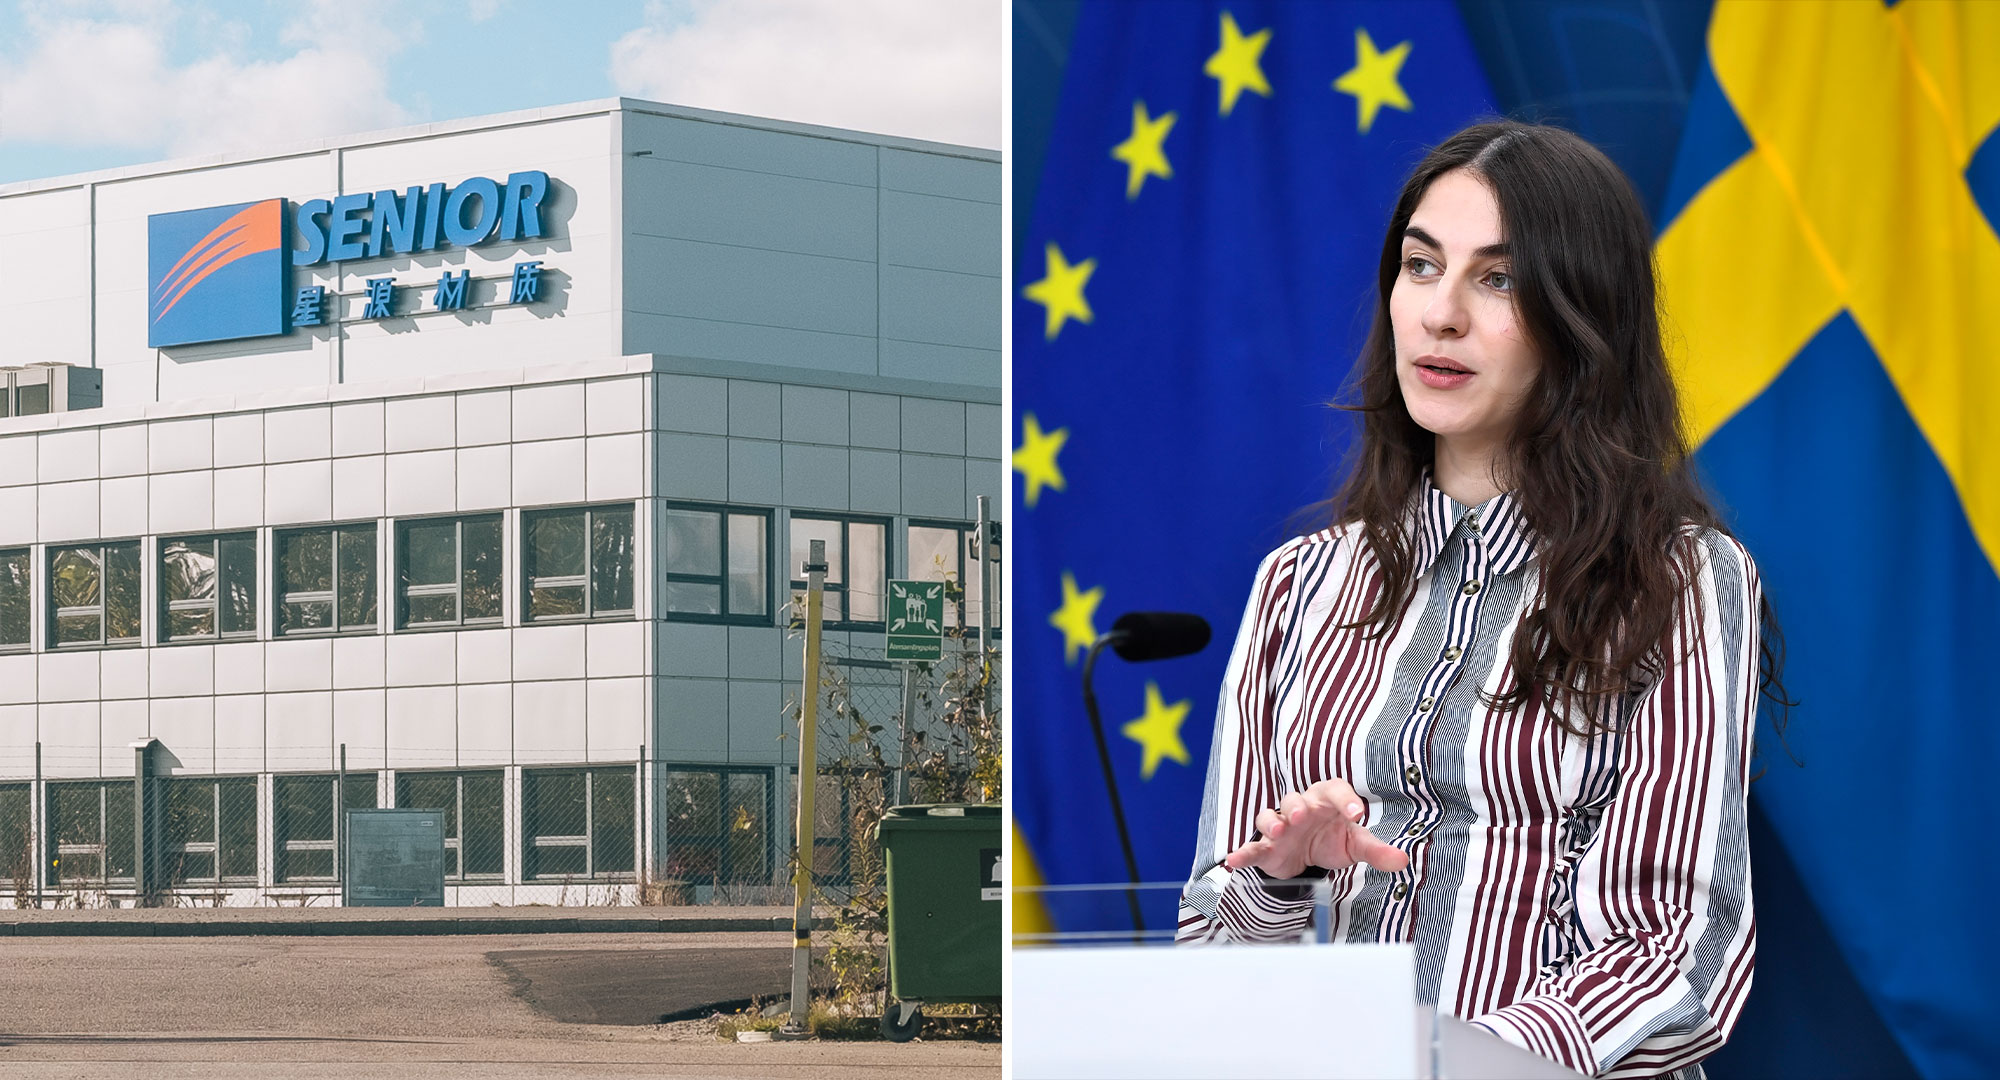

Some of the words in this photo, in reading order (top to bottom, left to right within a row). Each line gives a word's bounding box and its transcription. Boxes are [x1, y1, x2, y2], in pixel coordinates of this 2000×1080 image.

[293, 170, 549, 265] SENIOR
[292, 261, 543, 327] 星源材质
